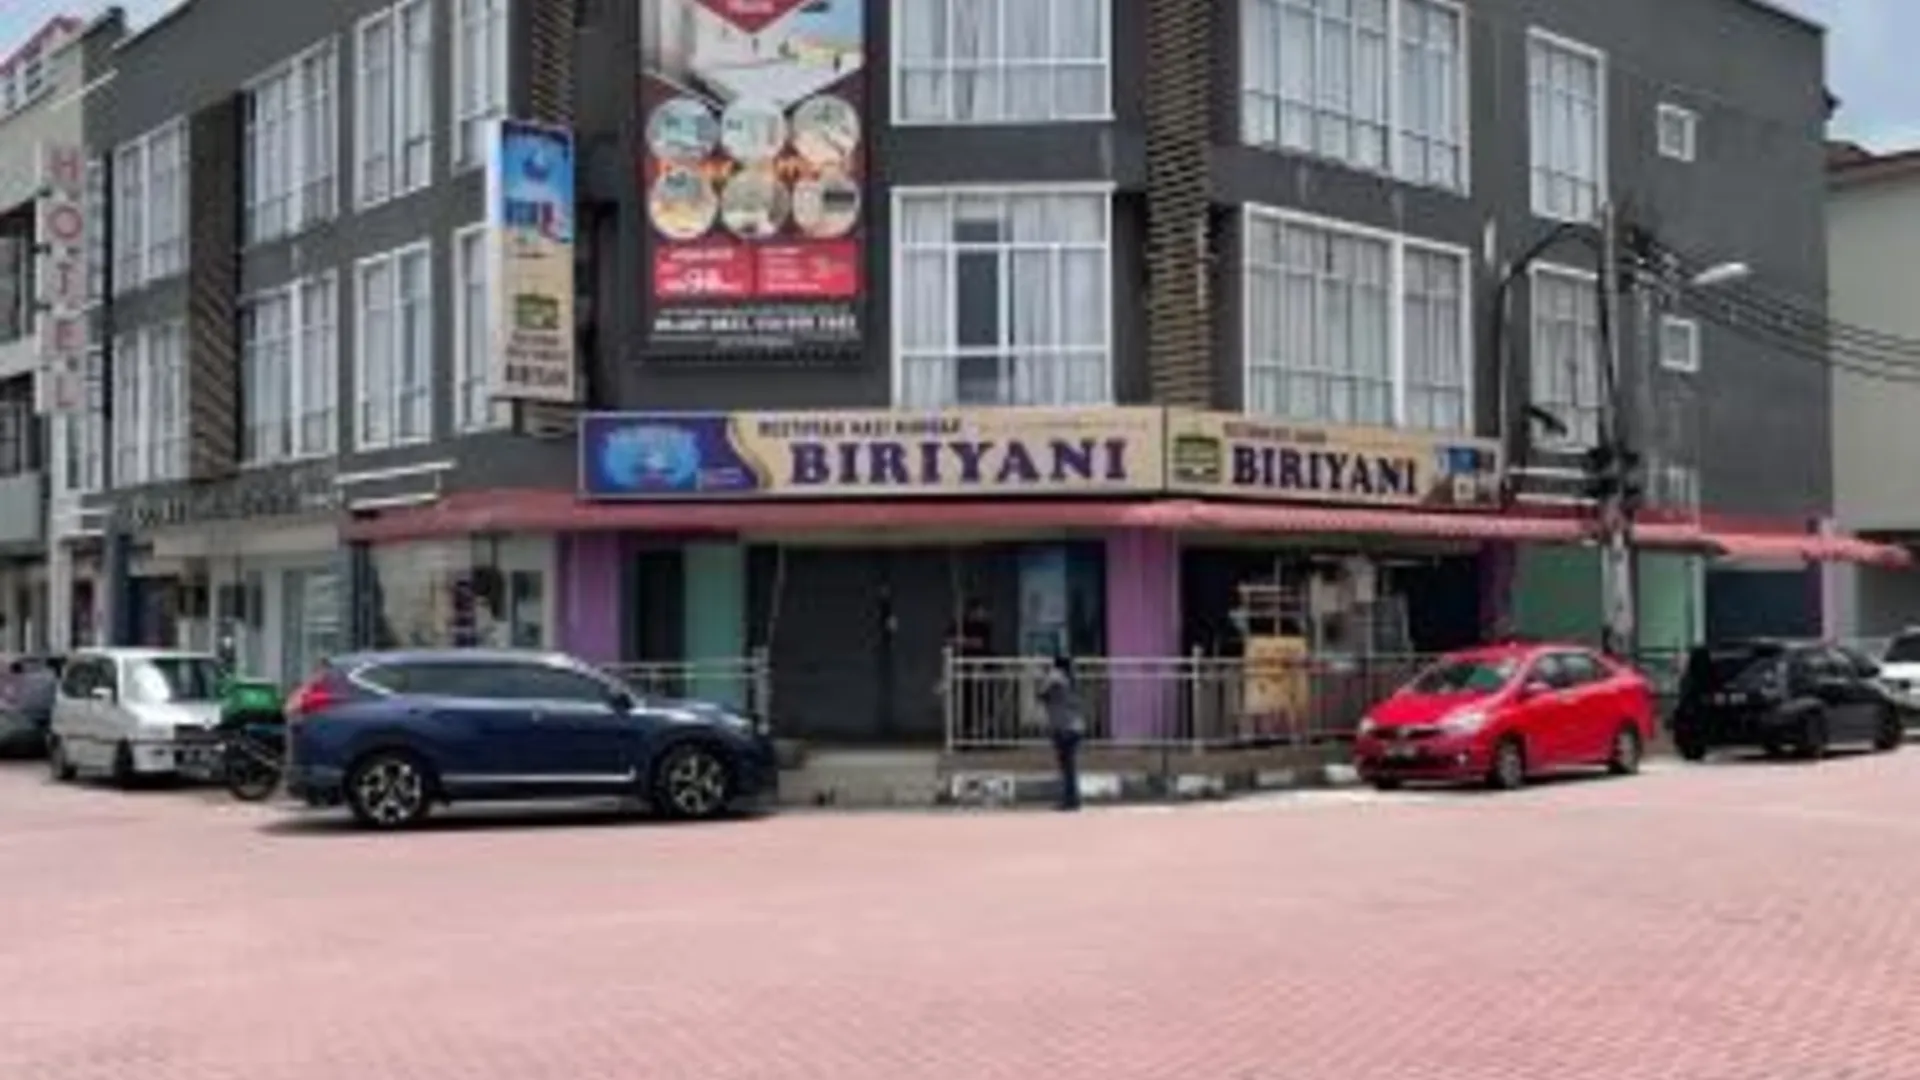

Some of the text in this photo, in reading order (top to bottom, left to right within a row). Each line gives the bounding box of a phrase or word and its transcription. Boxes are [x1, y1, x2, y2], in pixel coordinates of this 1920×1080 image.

[50, 148, 84, 410] HOTEL
[790, 437, 1127, 484] BIRIYANI
[1232, 444, 1416, 494] BIRIYANI
